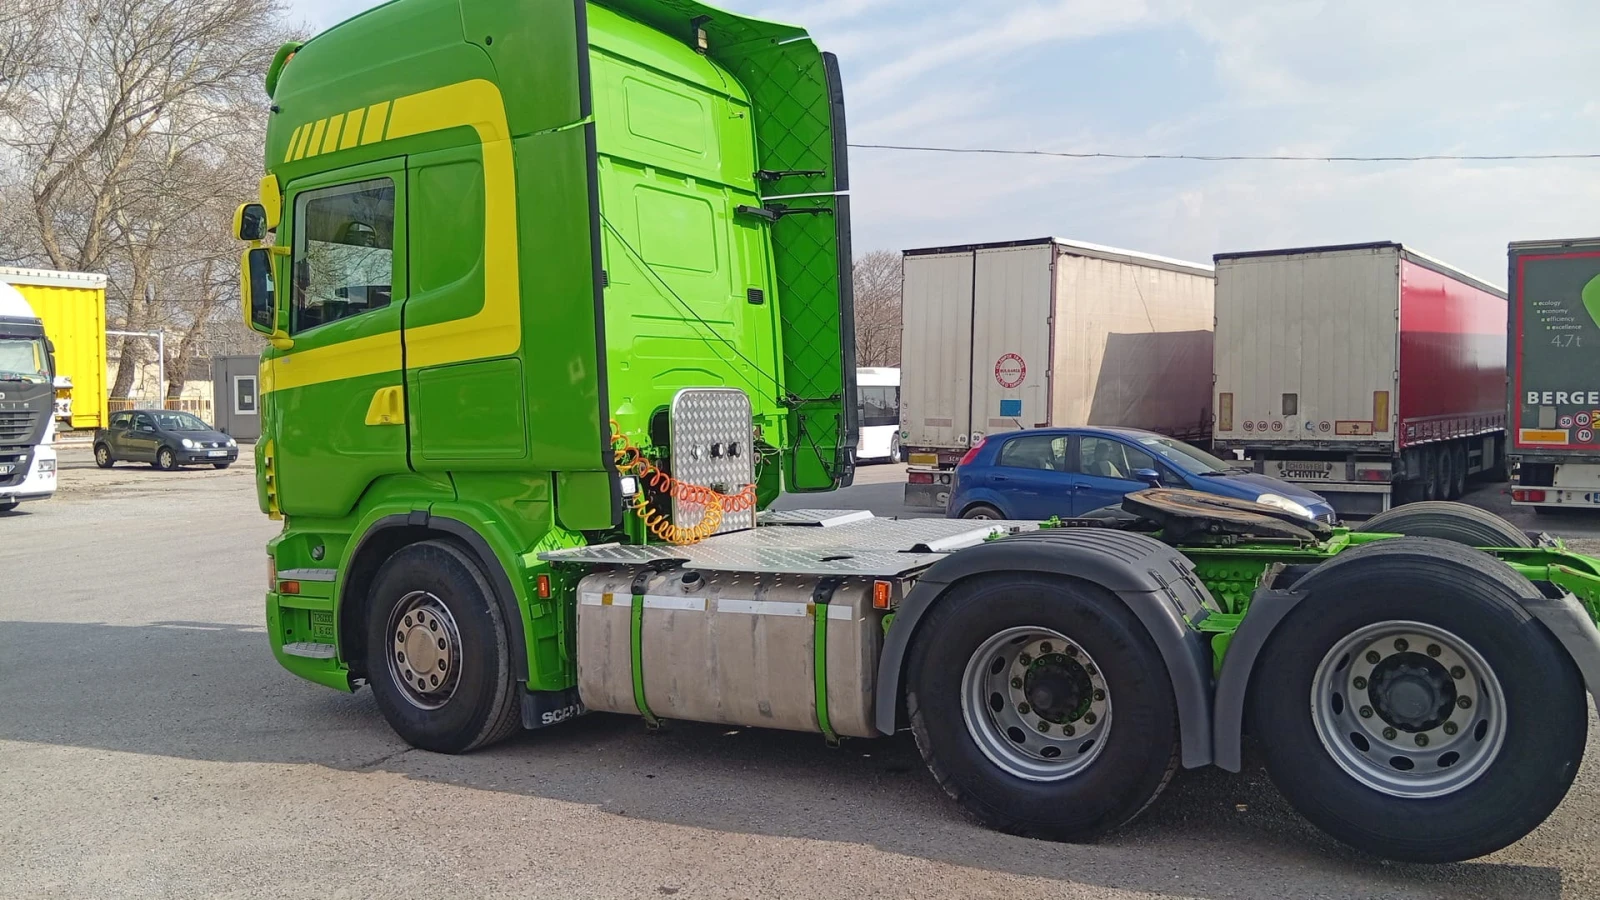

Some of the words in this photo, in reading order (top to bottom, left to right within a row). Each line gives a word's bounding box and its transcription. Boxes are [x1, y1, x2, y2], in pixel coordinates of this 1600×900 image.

[1551, 334, 1574, 347] 4.7
[1527, 391, 1599, 404] BERGE
[1577, 415, 1588, 424] 60
[1580, 431, 1590, 439] 70
[1280, 470, 1330, 478] SCHMITZ
